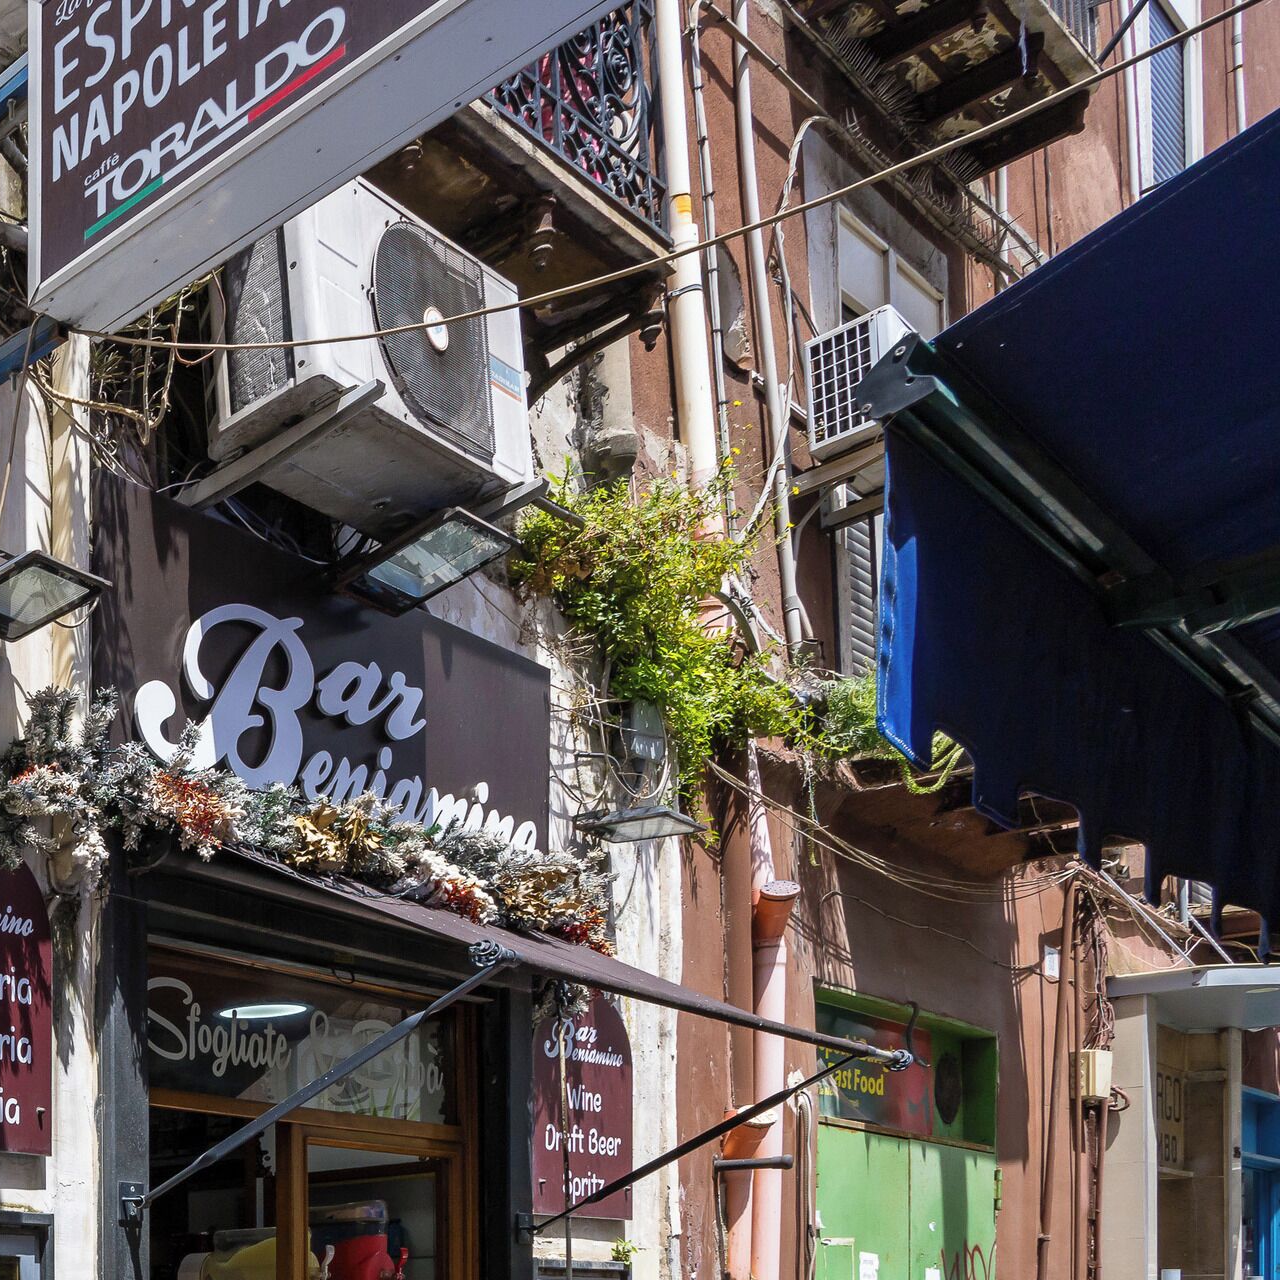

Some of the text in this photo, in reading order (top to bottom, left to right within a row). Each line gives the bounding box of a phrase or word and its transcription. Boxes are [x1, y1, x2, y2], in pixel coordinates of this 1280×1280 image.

[84, 7, 346, 218] TORALDO
[84, 153, 120, 186] caffè
[135, 604, 427, 790] Bar
[147, 976, 292, 1077] Sfogliate
[543, 1017, 598, 1060] Bar
[566, 1084, 602, 1113] Wine
[854, 1068, 884, 1096] Food
[588, 1127, 622, 1157] Beer
